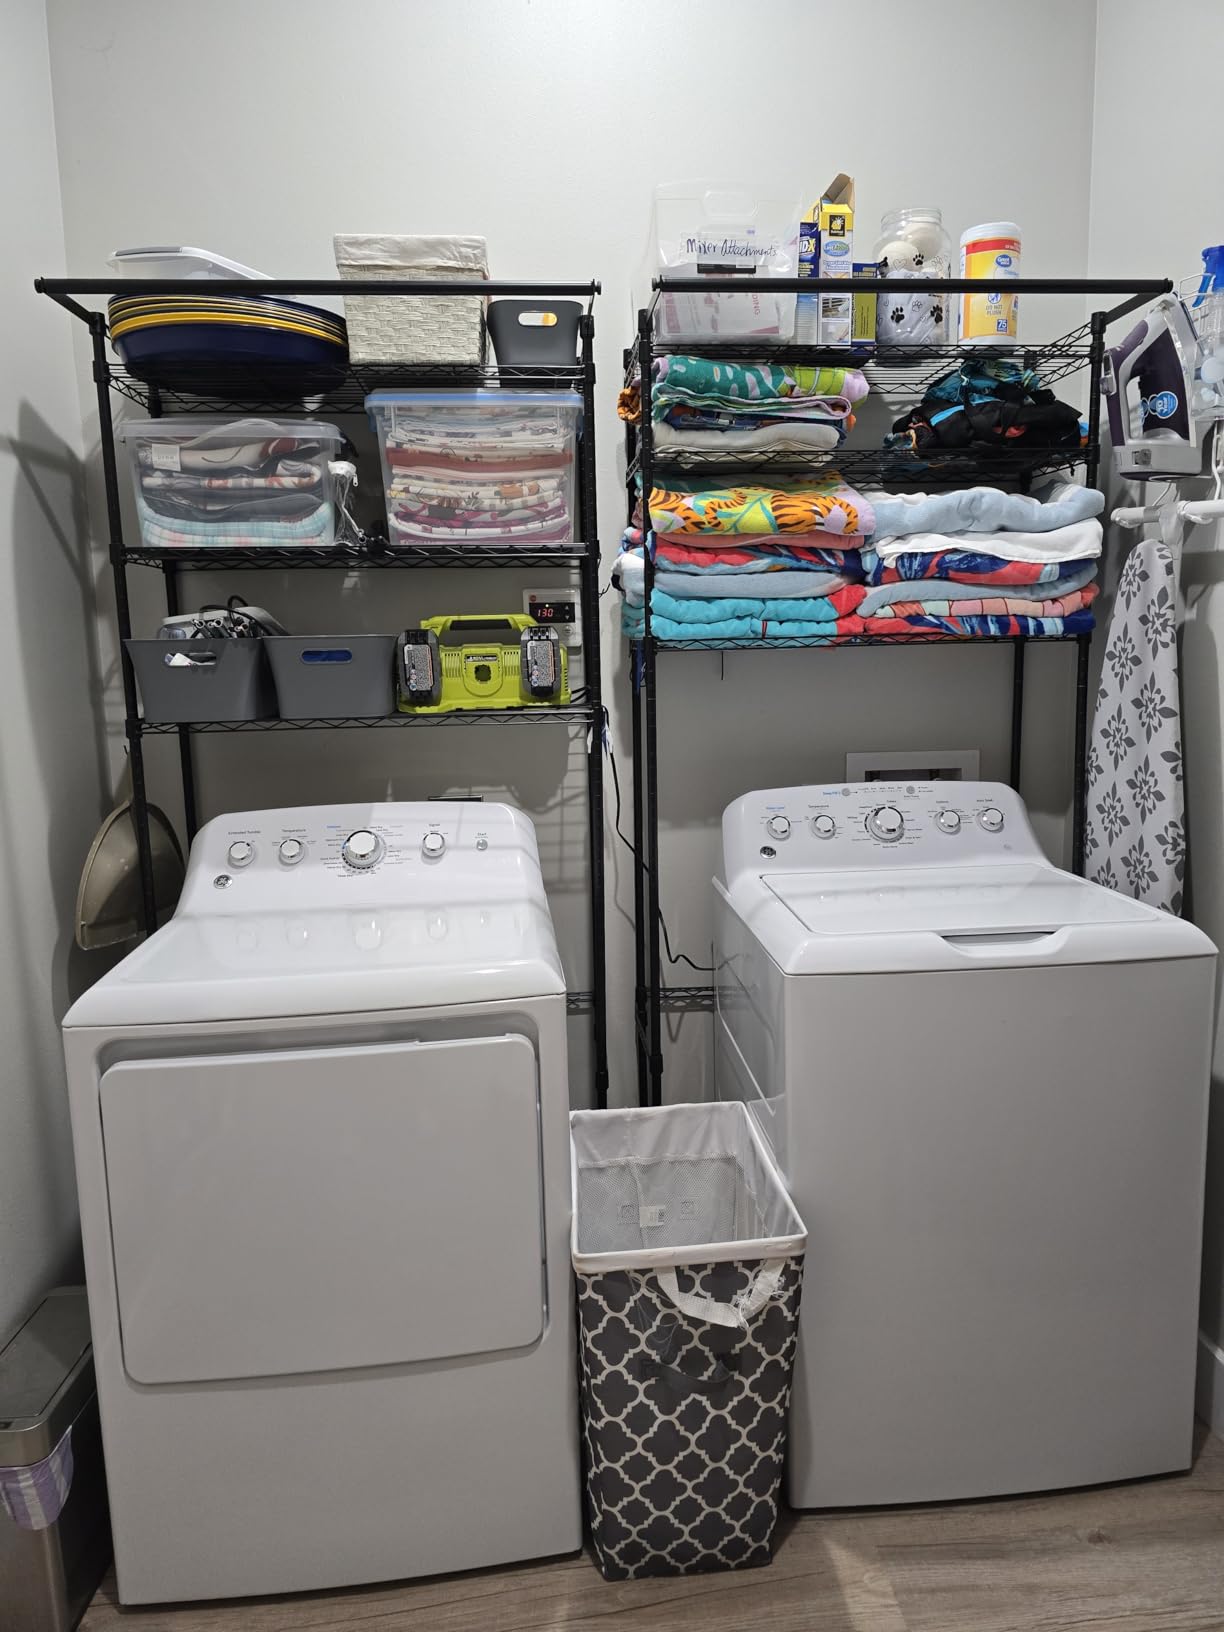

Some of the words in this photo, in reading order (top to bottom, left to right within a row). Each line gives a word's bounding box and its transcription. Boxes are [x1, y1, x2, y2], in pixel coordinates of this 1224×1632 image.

[686, 238, 718, 254] Mixer
[720, 239, 778, 257] Attachments
[799, 238, 816, 253] ID-X
[998, 319, 1007, 328] 75
[537, 608, 553, 617] 130
